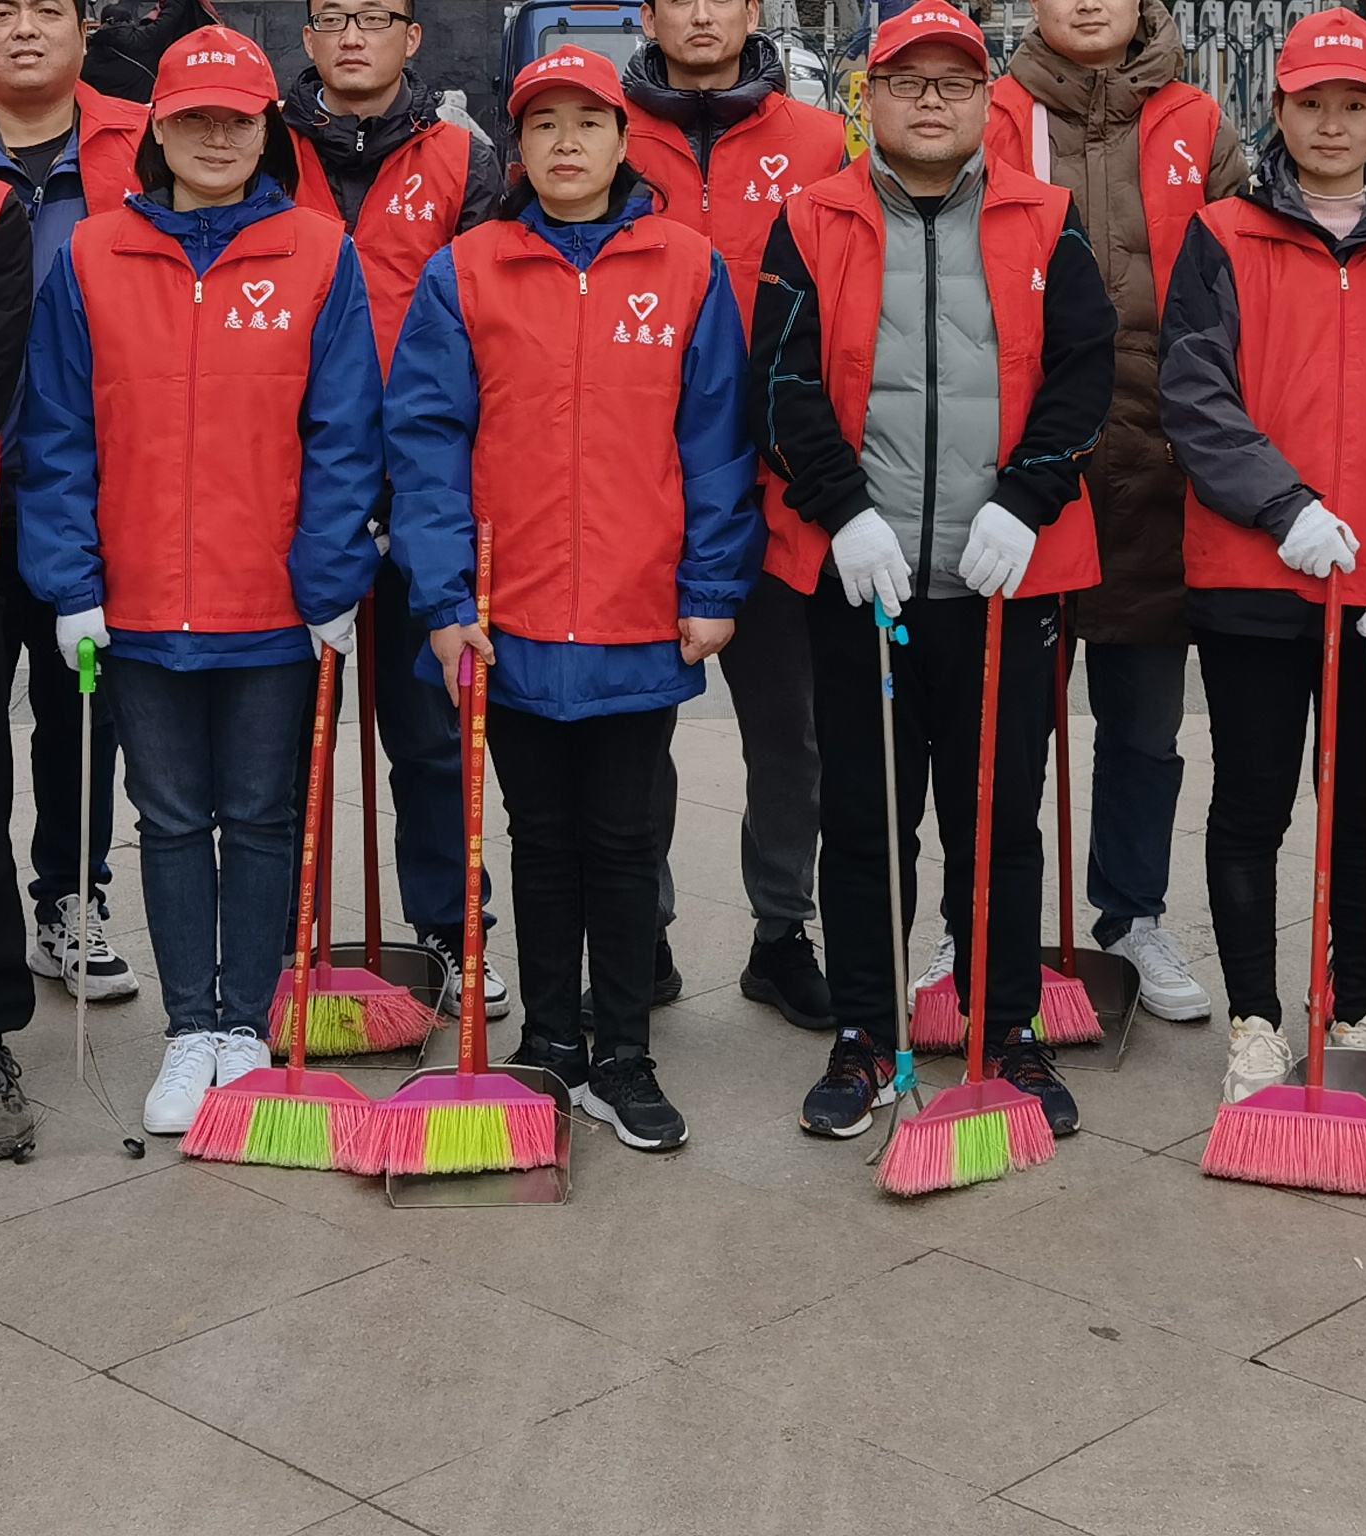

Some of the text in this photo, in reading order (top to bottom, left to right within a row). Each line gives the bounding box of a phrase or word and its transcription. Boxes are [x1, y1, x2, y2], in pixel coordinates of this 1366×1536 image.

[911, 11, 960, 28] 建发检测
[1313, 33, 1363, 50] 建发检测
[186, 50, 236, 66] 建发检测
[536, 56, 585, 73] 建发检测
[1167, 164, 1202, 185] 志愿
[385, 195, 435, 222] 志愿者
[224, 308, 292, 331] 志愿者
[612, 321, 675, 347] 志愿者
